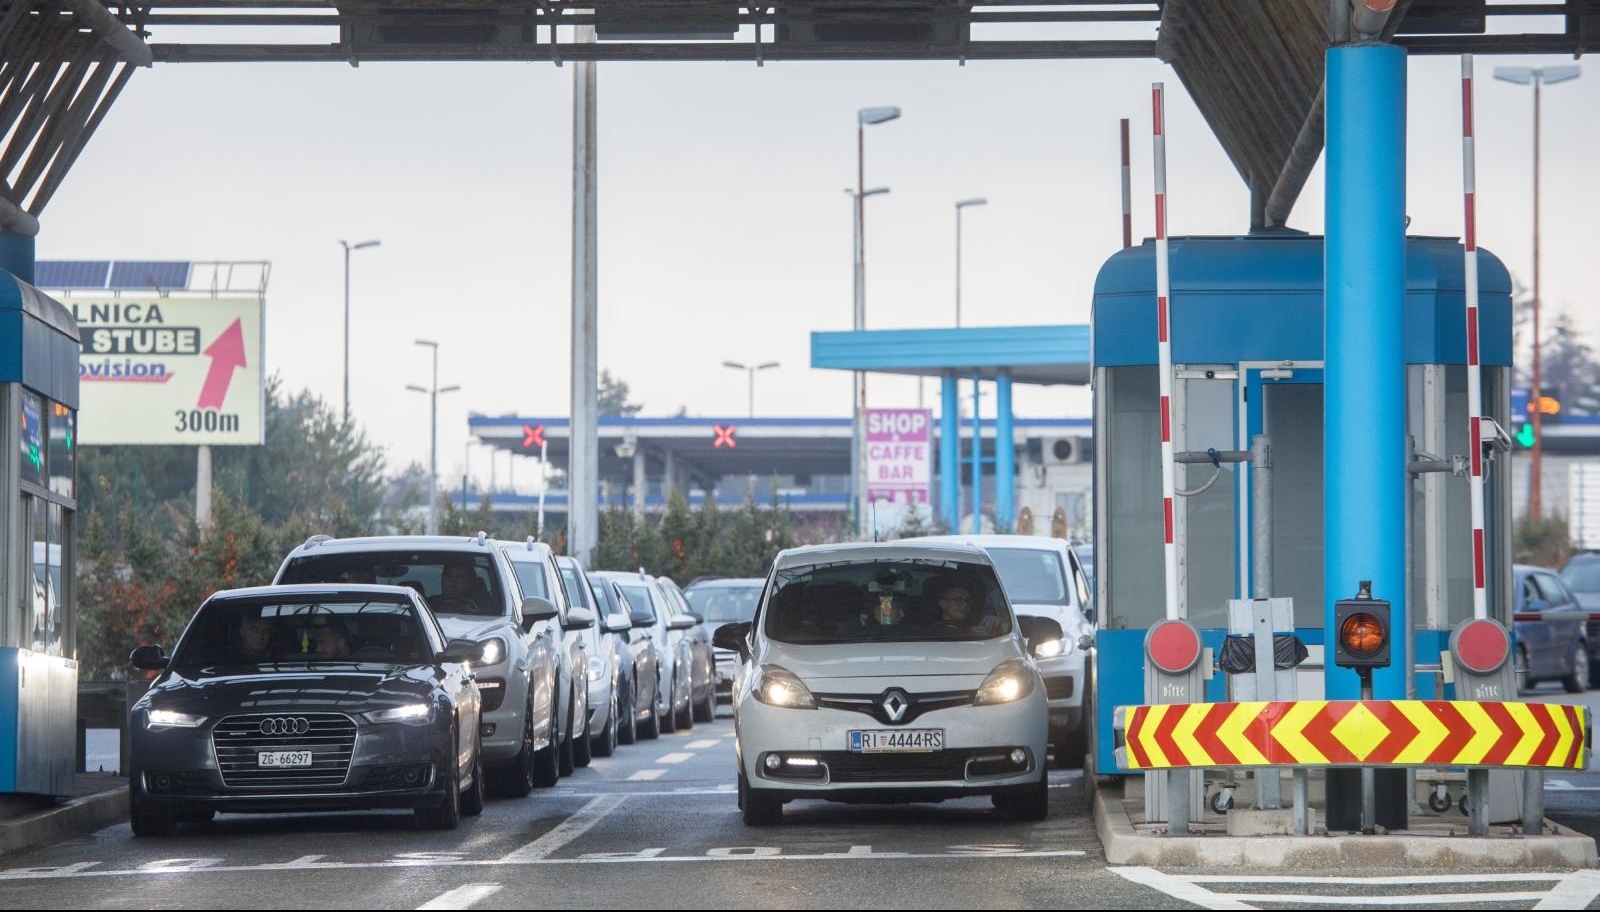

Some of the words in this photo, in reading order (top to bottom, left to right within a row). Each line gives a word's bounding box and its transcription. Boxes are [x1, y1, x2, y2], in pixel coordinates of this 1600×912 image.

[92, 328, 196, 353] STUBE
[174, 410, 239, 432] 300m
[869, 412, 926, 434] SHOP
[870, 446, 924, 461] CAFFE
[879, 465, 912, 480] BAR
[862, 733, 877, 748] RI
